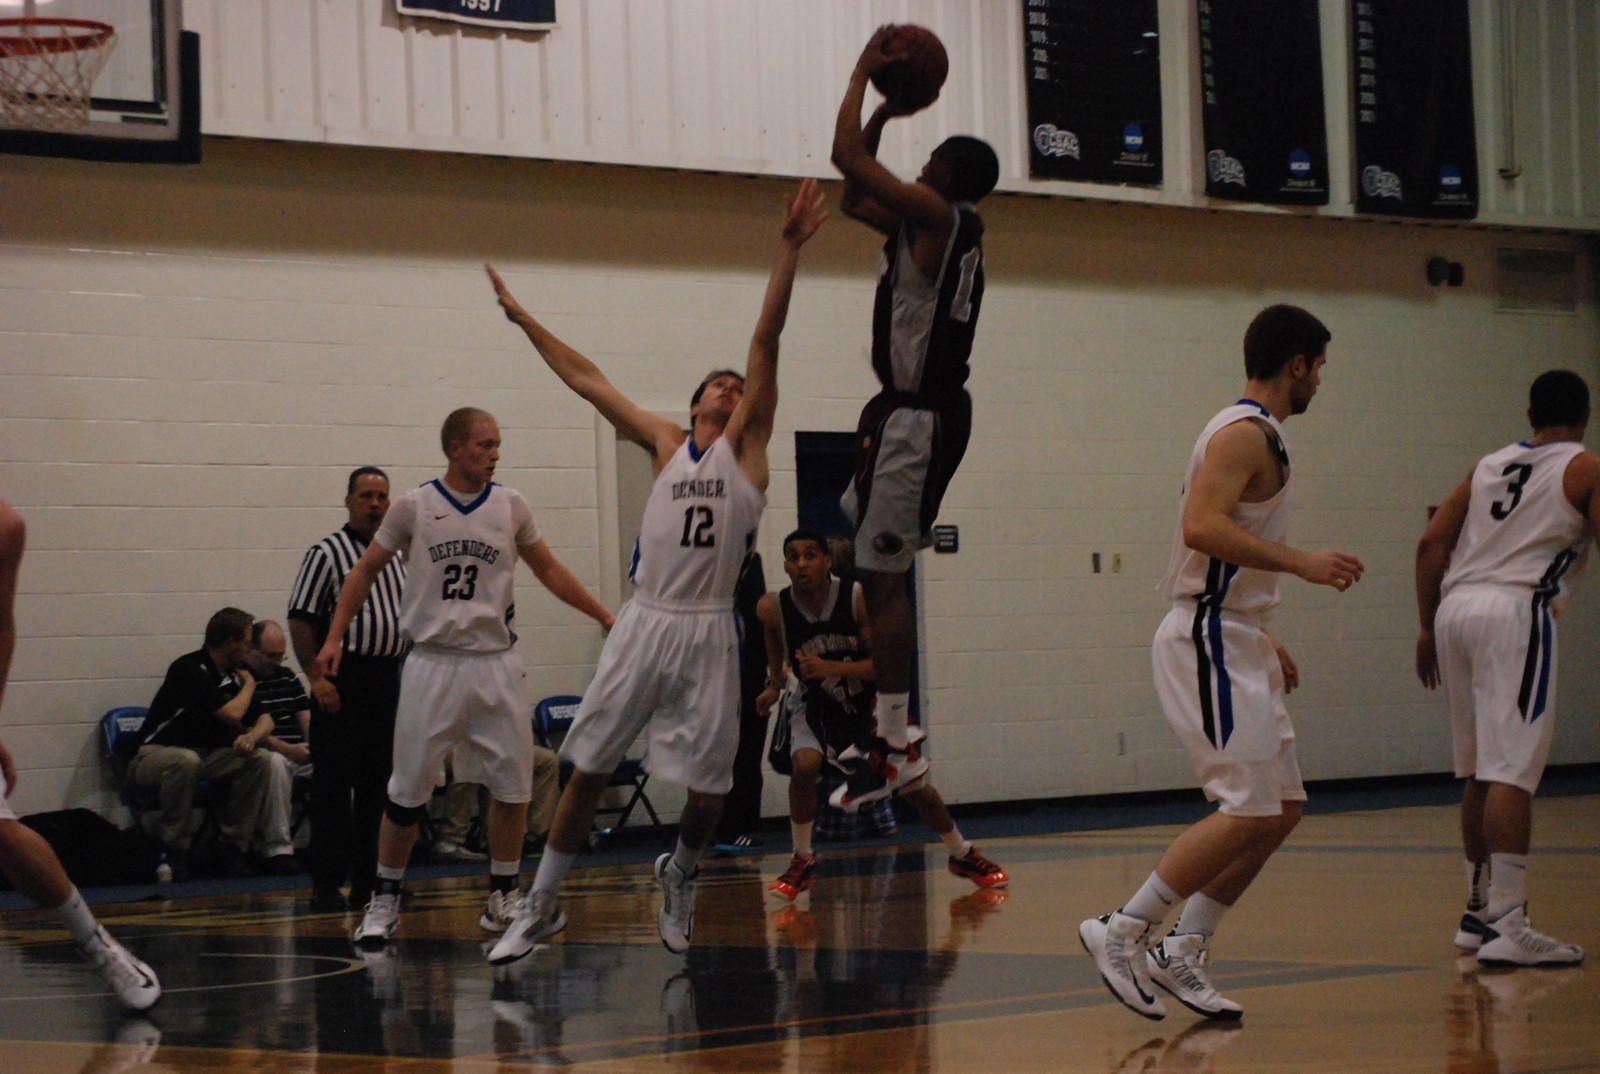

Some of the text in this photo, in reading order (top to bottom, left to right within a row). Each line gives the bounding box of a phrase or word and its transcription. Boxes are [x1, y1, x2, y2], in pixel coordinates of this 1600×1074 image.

[1490, 463, 1533, 520] 3
[680, 505, 715, 547] 12
[428, 539, 500, 565] DEFENDERS
[442, 564, 478, 600] 23
